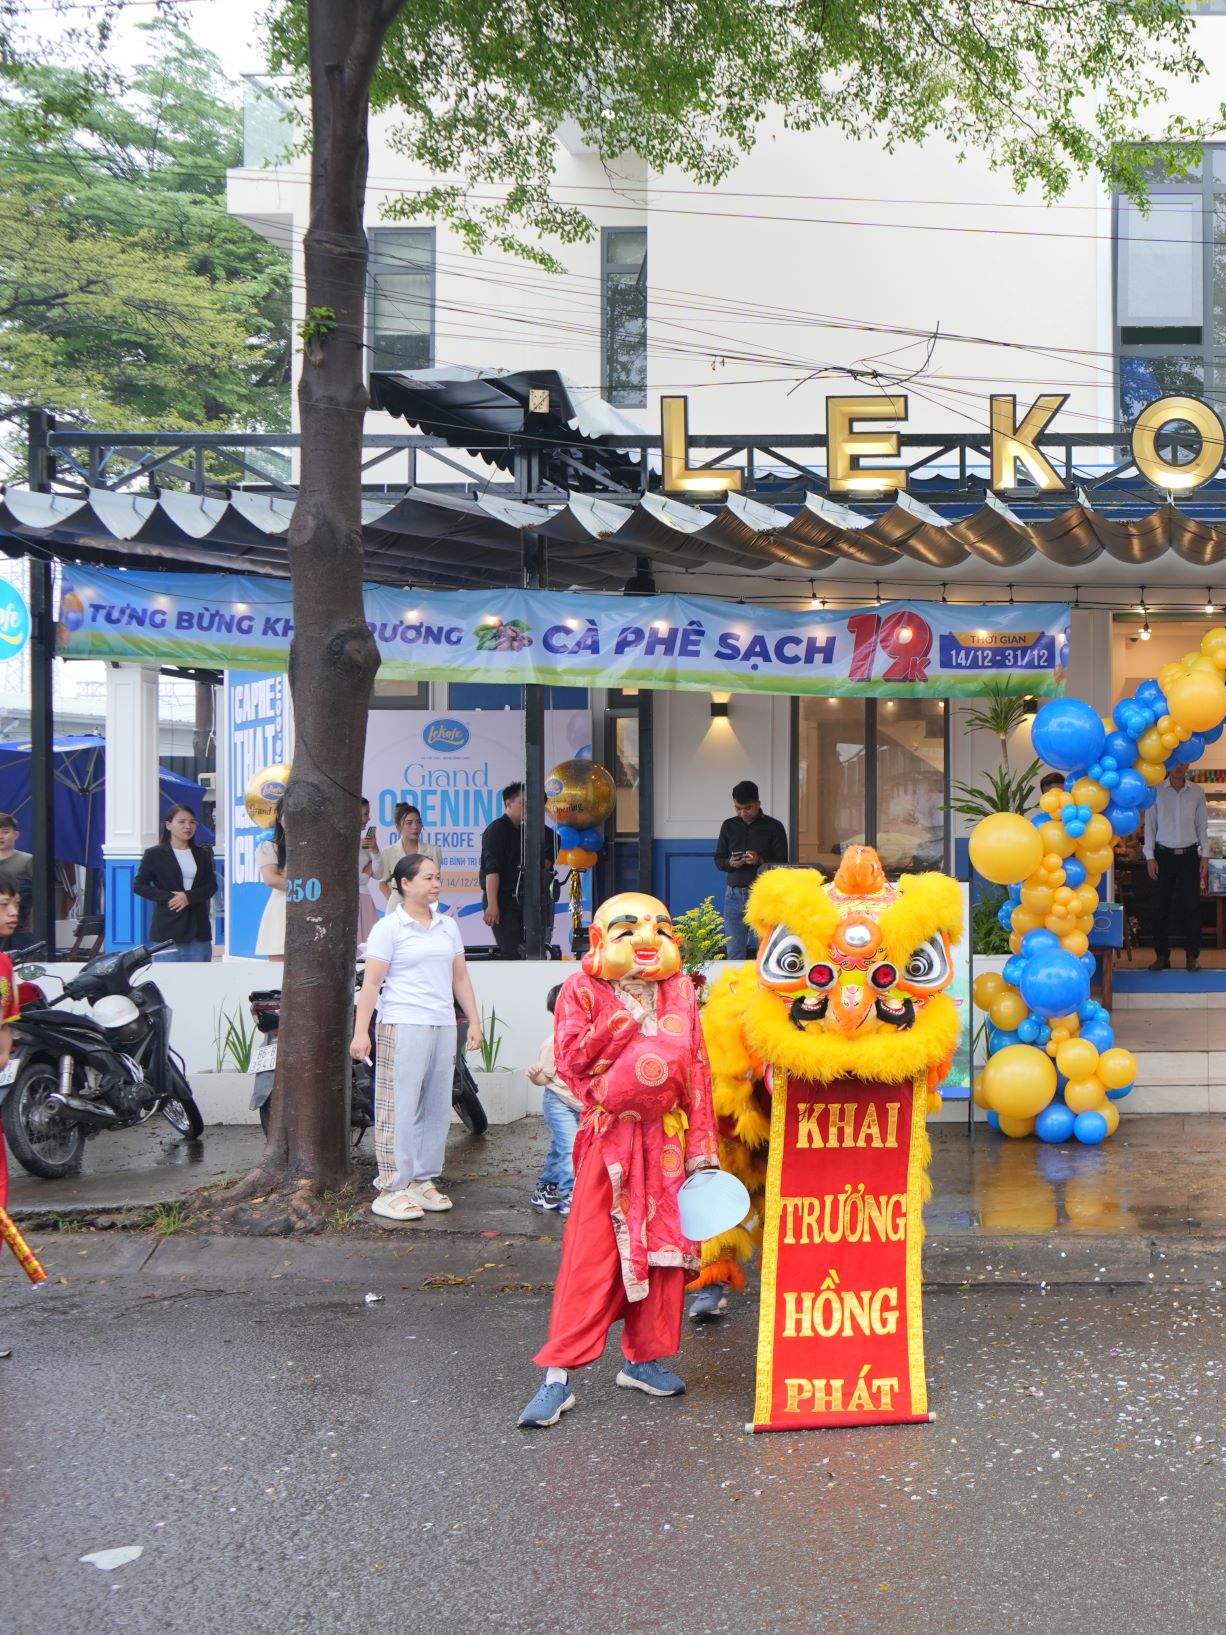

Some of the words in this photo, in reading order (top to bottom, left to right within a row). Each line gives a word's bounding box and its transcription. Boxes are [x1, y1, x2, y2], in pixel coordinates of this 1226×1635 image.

[175, 607, 256, 635] BỪNG
[262, 616, 294, 637] KH
[542, 619, 600, 655] CÀ
[614, 620, 706, 657] PHÊ
[714, 631, 837, 671] SẠCH
[1000, 635, 1026, 644] GIAN
[950, 650, 993, 667] 14/12
[1005, 649, 1048, 666] 31/12
[404, 762, 489, 788] Grand
[287, 877, 322, 903] 250
[447, 878, 480, 888] 14/12/2
[796, 1102, 900, 1149] KHAI
[782, 1269, 899, 1338] HỒNG
[783, 1364, 899, 1413] PHÁT
